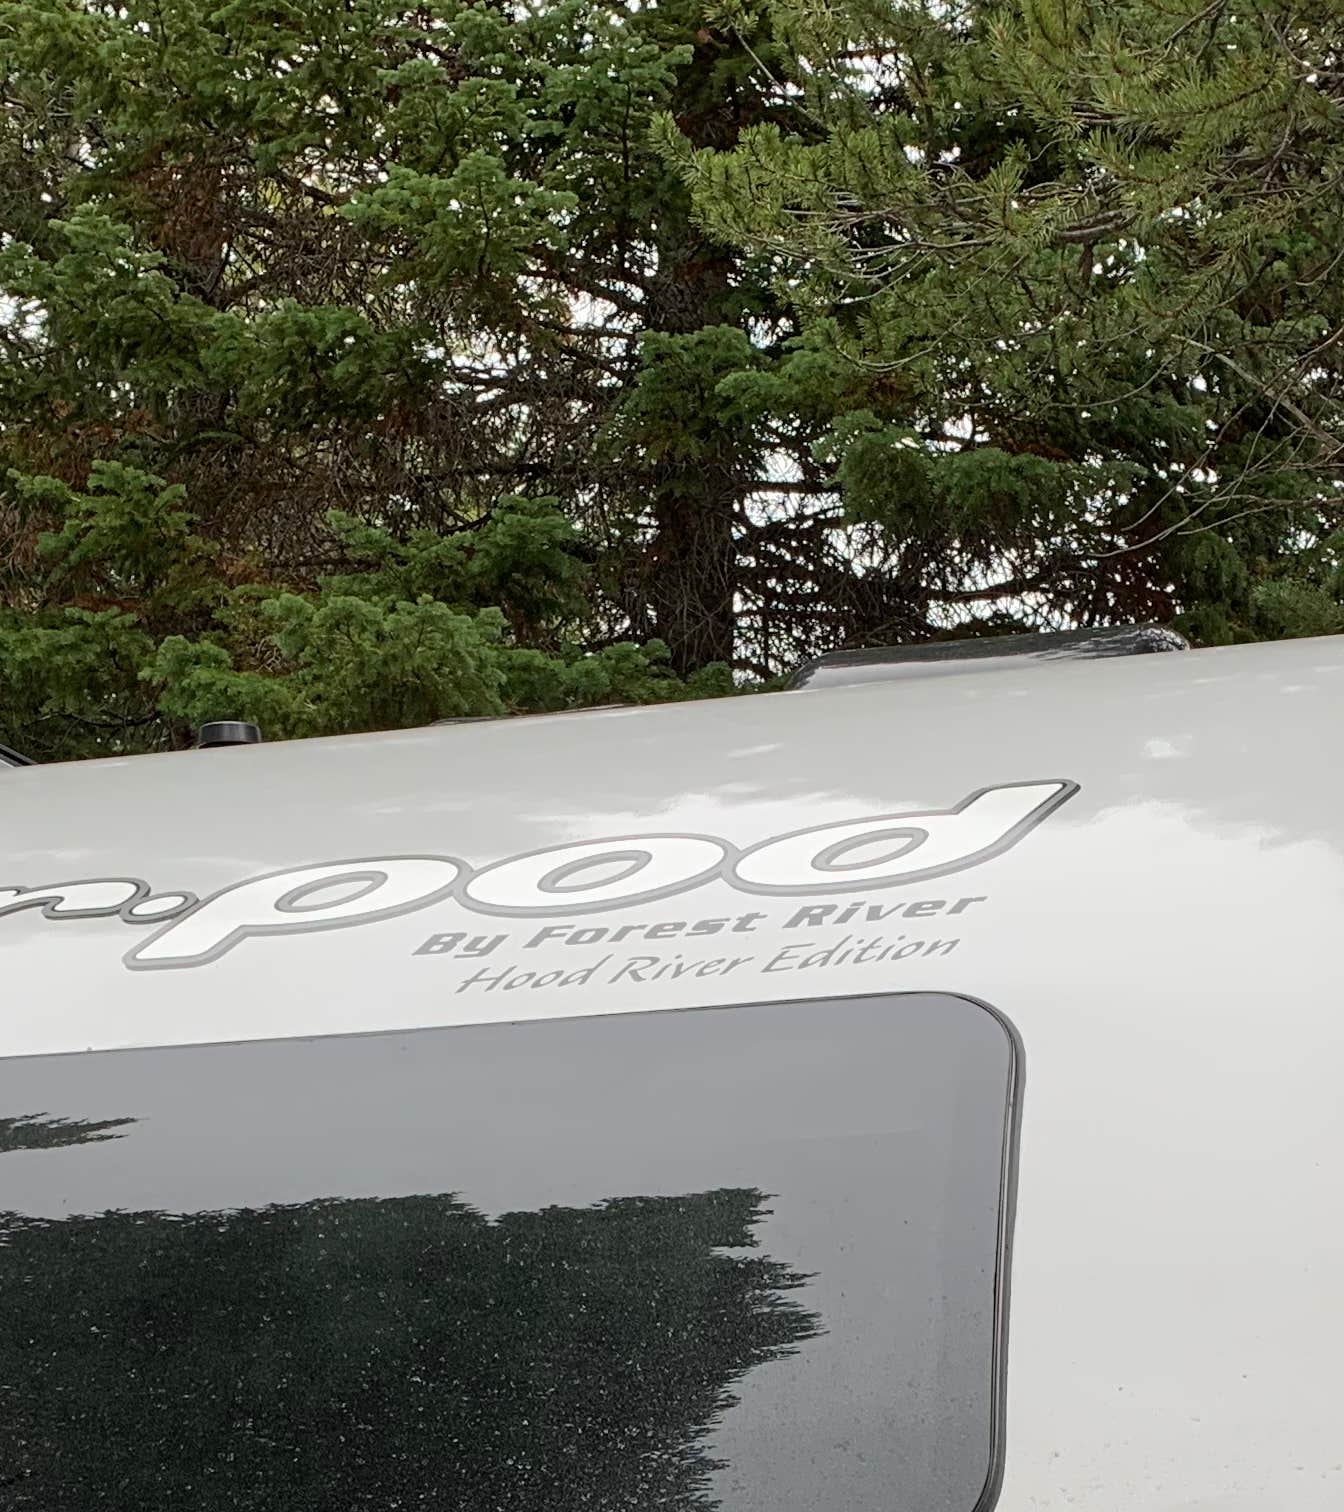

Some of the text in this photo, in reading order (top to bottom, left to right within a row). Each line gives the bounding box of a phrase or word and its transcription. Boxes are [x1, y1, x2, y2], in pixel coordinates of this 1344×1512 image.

[412, 895, 988, 959] By Forest River
[454, 934, 961, 994] Hood River Edition
